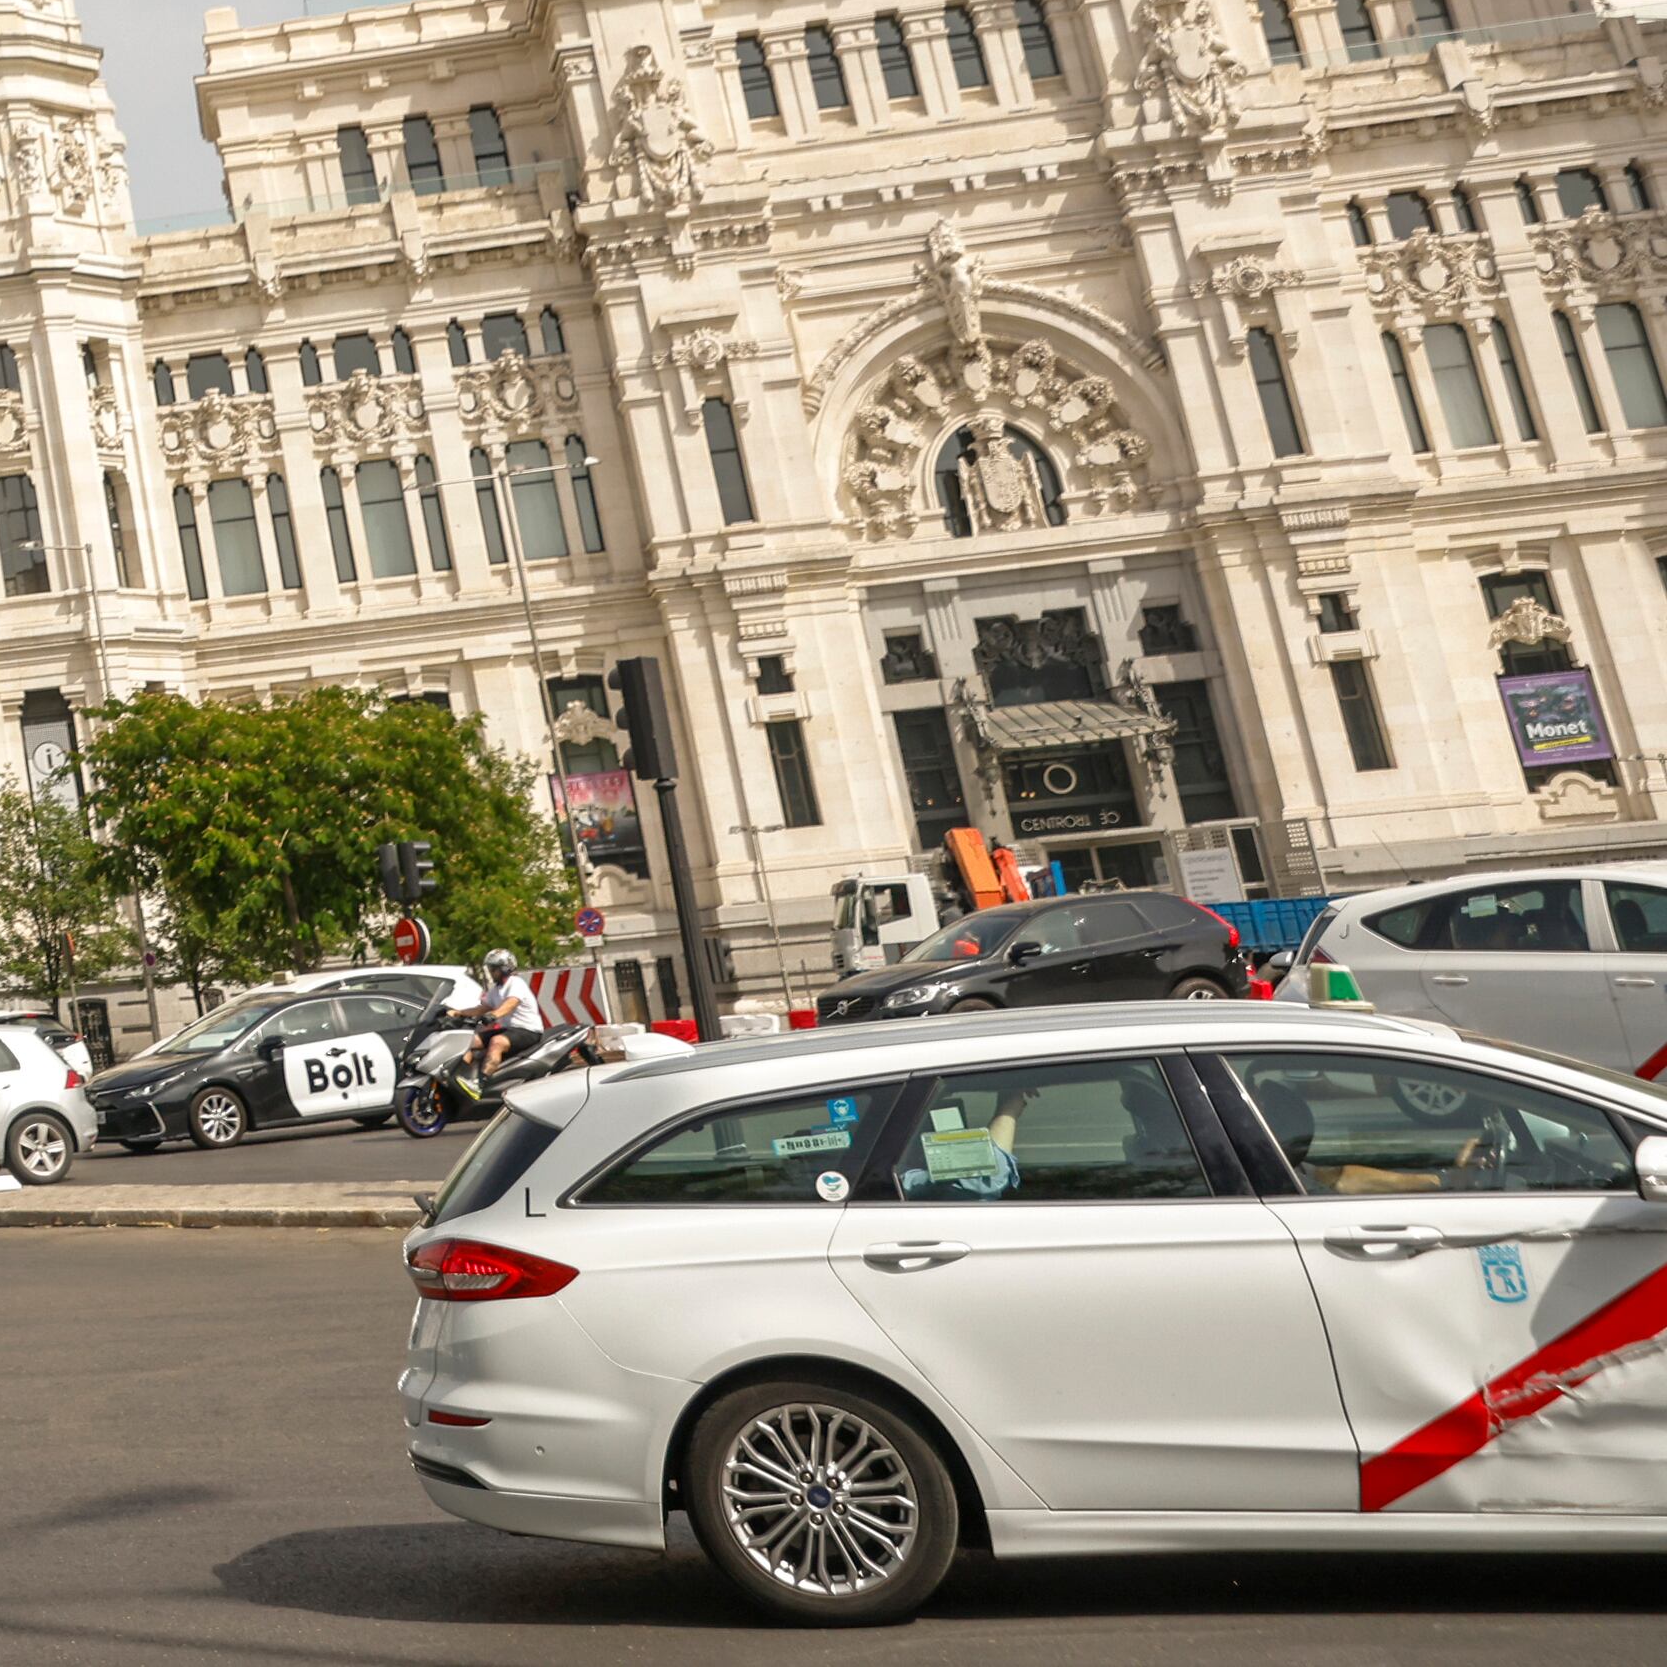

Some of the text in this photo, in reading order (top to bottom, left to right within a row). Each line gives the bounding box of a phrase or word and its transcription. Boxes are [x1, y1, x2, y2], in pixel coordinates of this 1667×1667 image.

[1525, 719, 1588, 739] Monet
[303, 1051, 377, 1096] Bolt
[525, 1186, 546, 1218] L
